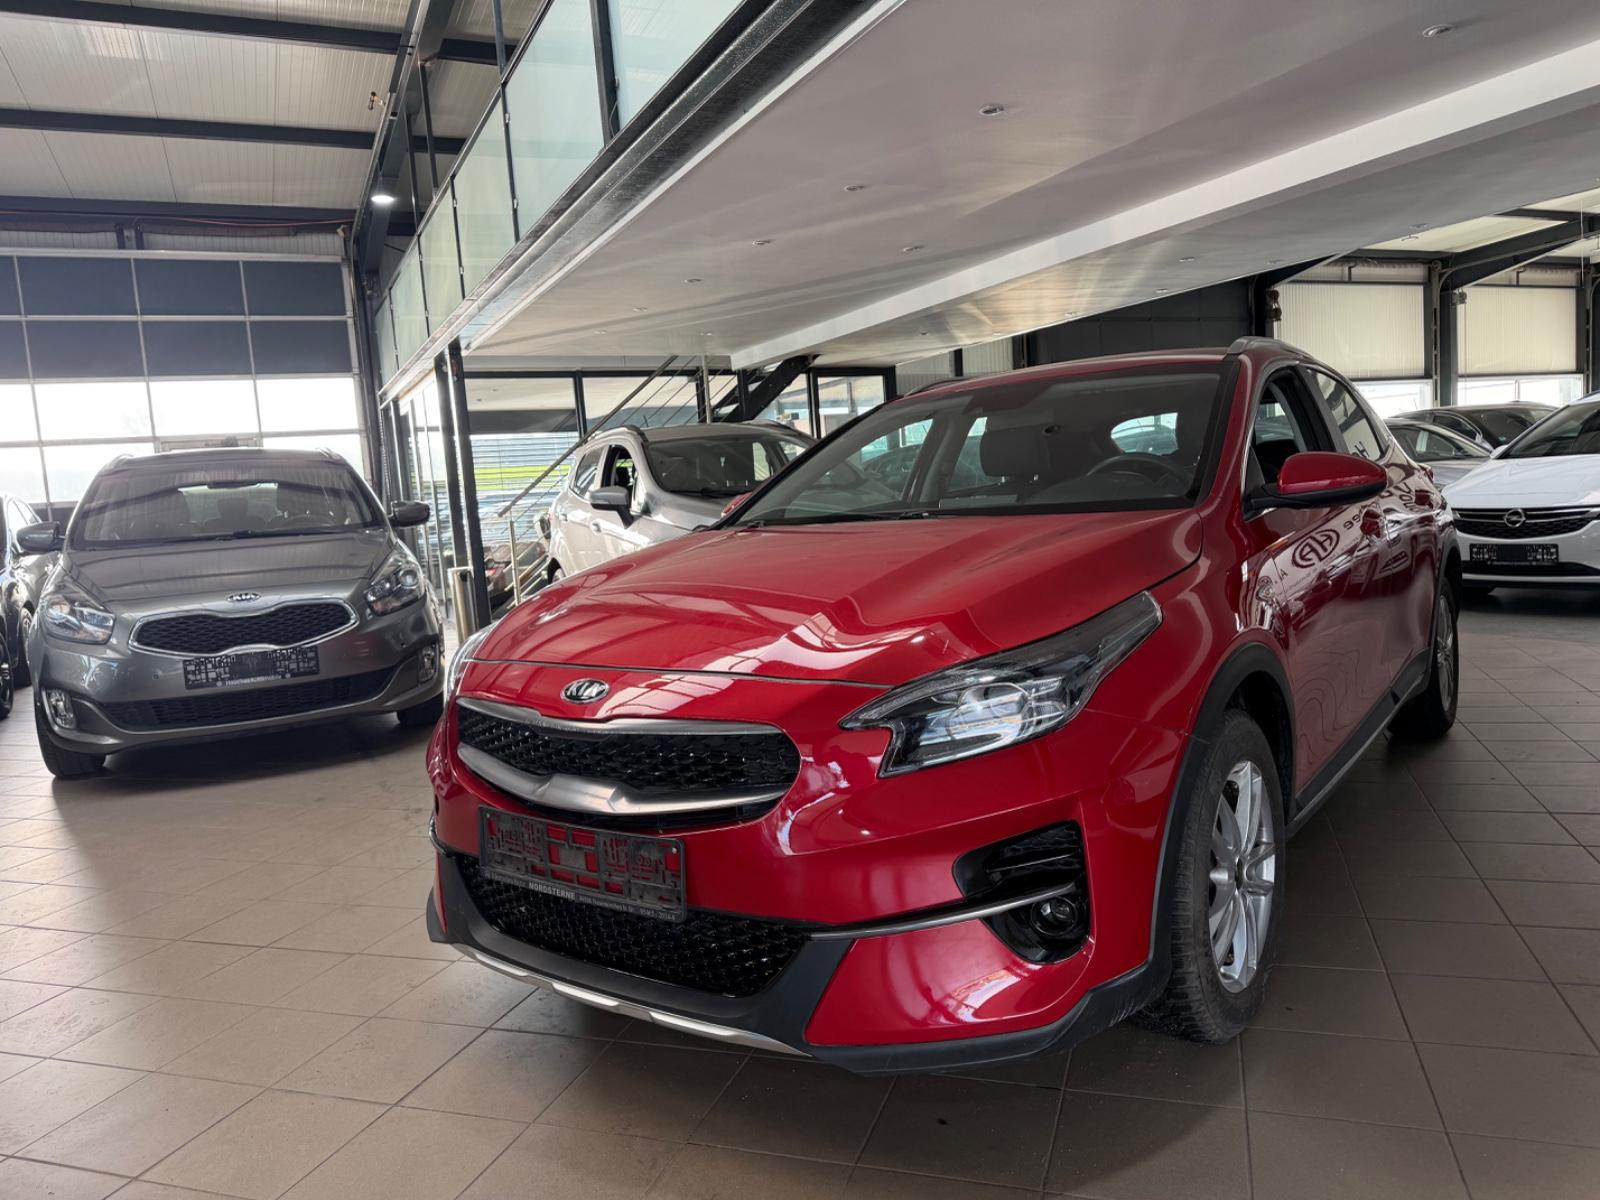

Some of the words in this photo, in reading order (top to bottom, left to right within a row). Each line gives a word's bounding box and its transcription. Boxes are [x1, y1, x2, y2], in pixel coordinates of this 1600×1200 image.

[229, 592, 261, 601] KIA
[565, 680, 607, 699] KIA
[528, 882, 576, 900] NORDSTERNE
